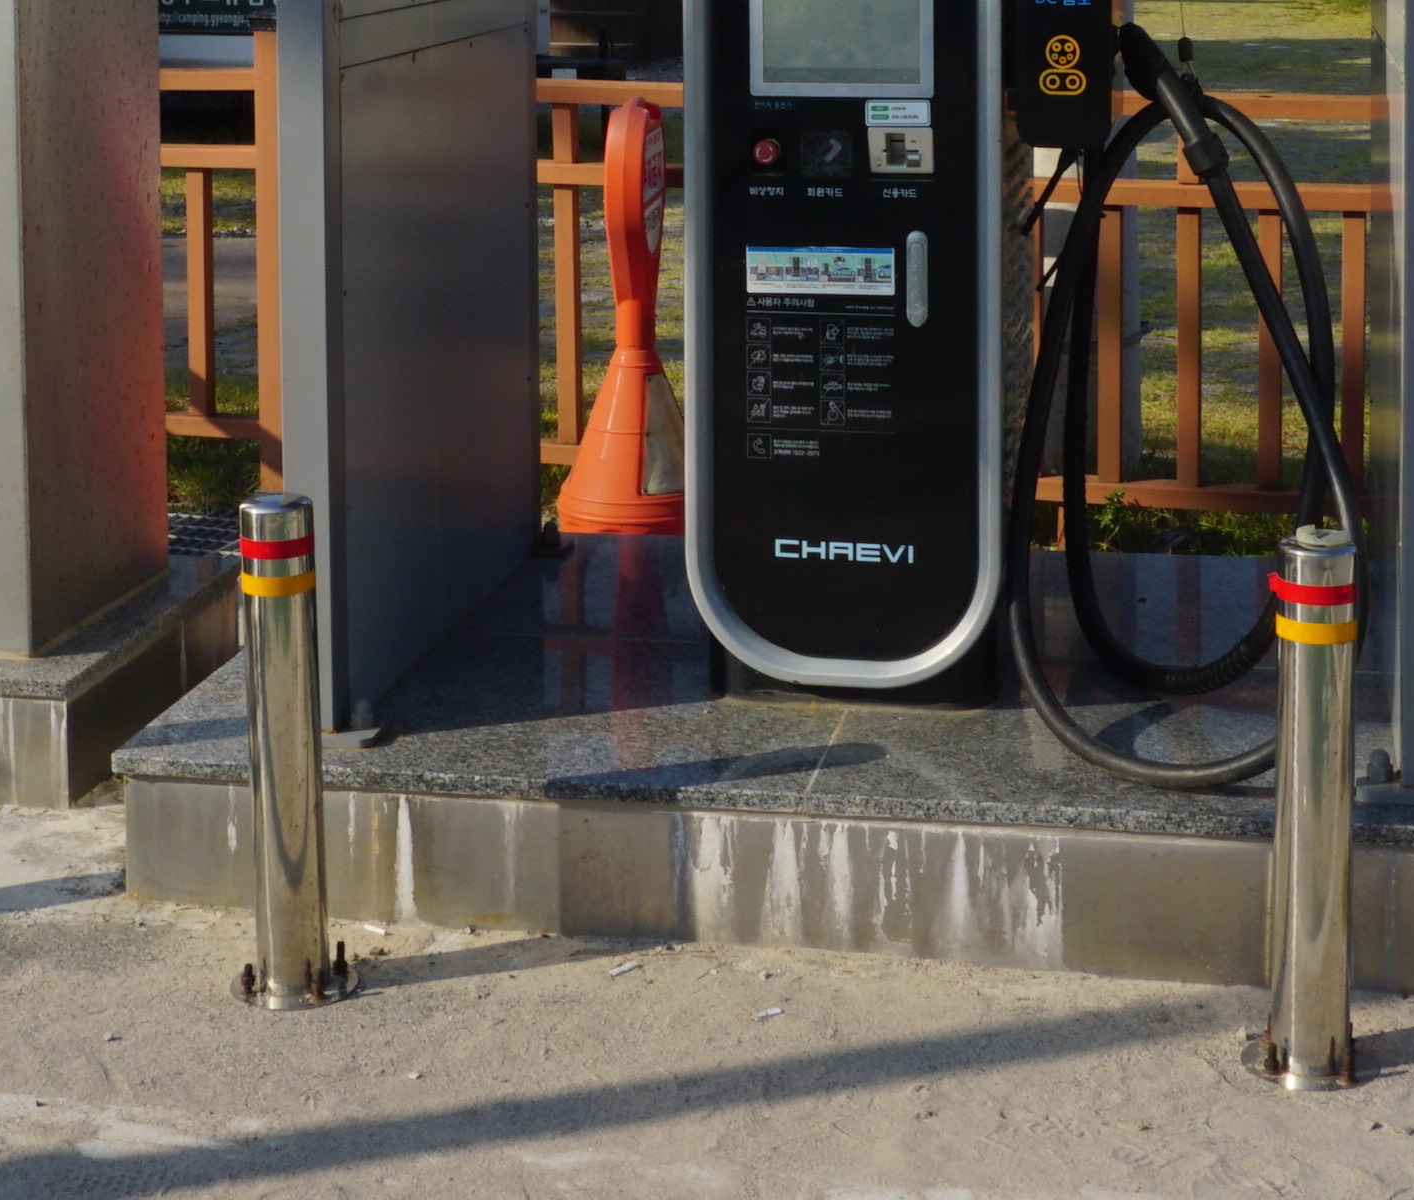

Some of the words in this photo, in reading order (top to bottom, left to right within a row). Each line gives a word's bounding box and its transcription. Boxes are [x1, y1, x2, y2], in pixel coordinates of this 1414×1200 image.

[806, 187, 844, 198] 회원카드
[882, 188, 917, 199] 신용카드
[774, 538, 915, 564] CHAEVI
